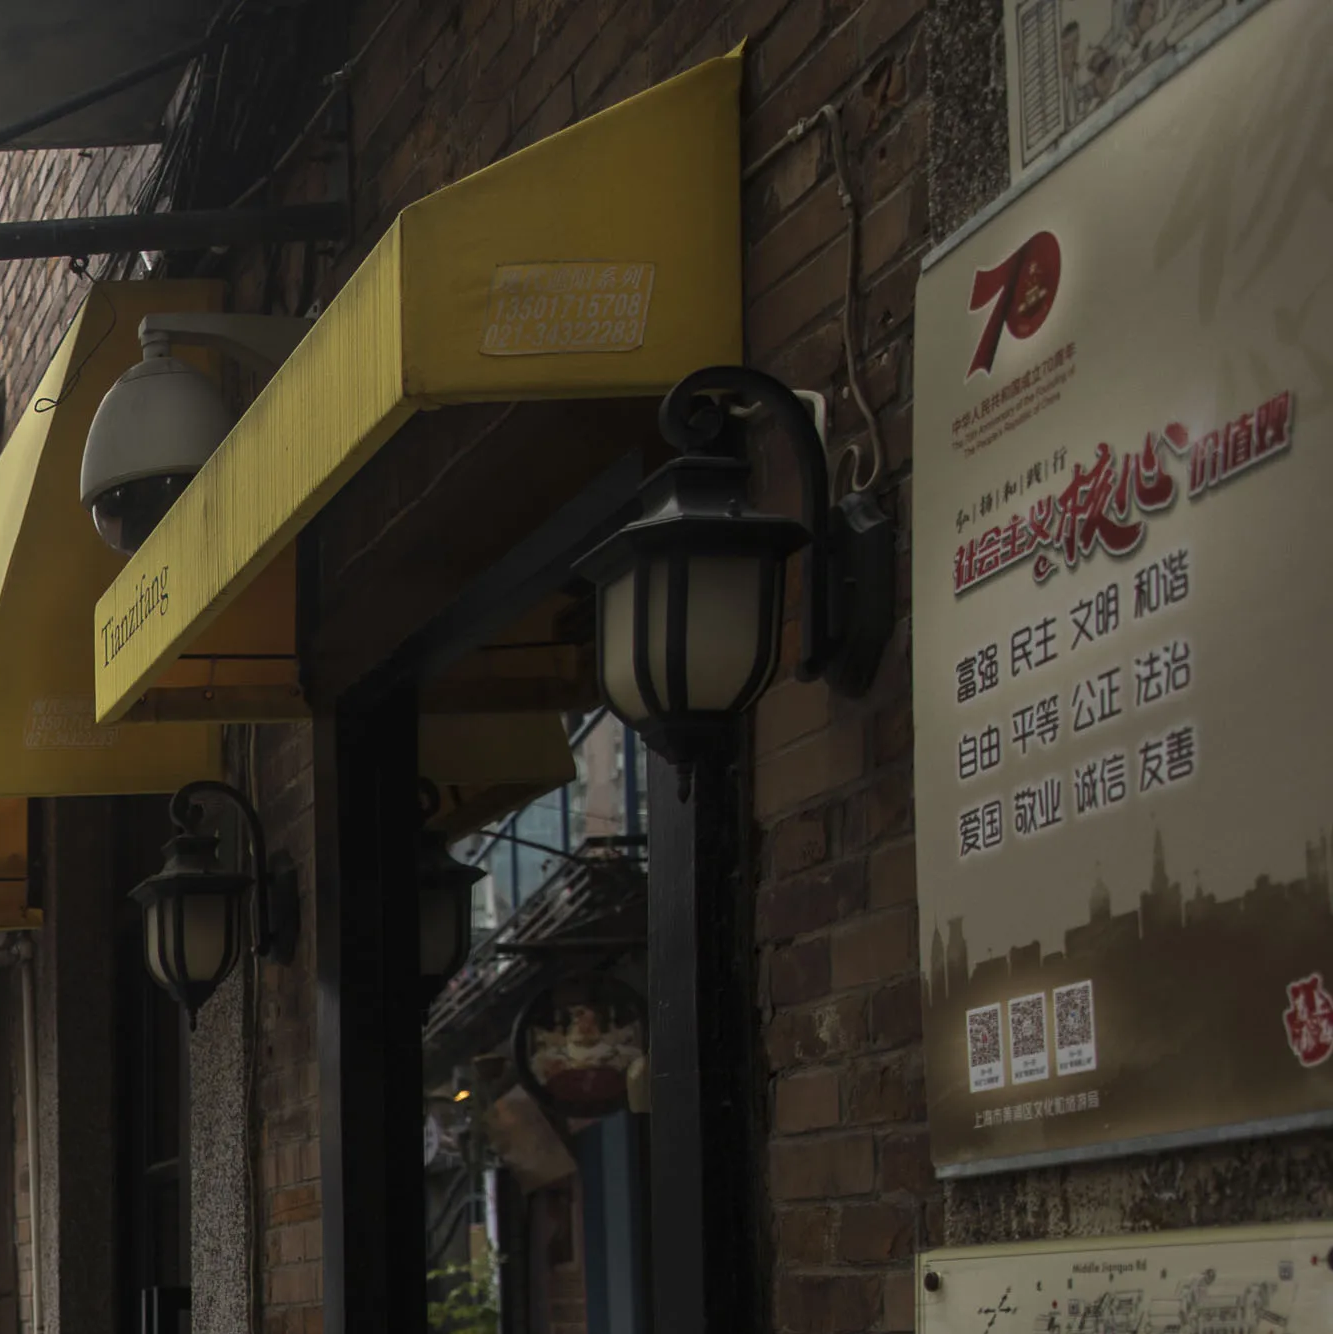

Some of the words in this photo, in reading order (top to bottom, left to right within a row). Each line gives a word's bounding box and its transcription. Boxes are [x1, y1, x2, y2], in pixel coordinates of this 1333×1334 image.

[966, 230, 1062, 380] 70
[100, 563, 171, 671] Tianzifang
[955, 643, 1001, 704] 富强
[1010, 615, 1059, 679] 民主
[1069, 583, 1120, 653] 文明
[1132, 547, 1191, 621] 和谐
[957, 724, 1001, 782] 自由
[1012, 693, 1061, 756] 平等
[1071, 666, 1123, 734] 公正
[1133, 639, 1193, 708] 法治
[958, 798, 1004, 858] 爱国
[1014, 776, 1063, 836] 敬业
[1073, 753, 1128, 816] 诚信
[1138, 725, 1196, 793] 友善
[1135, 1258, 1148, 1272] Rd
